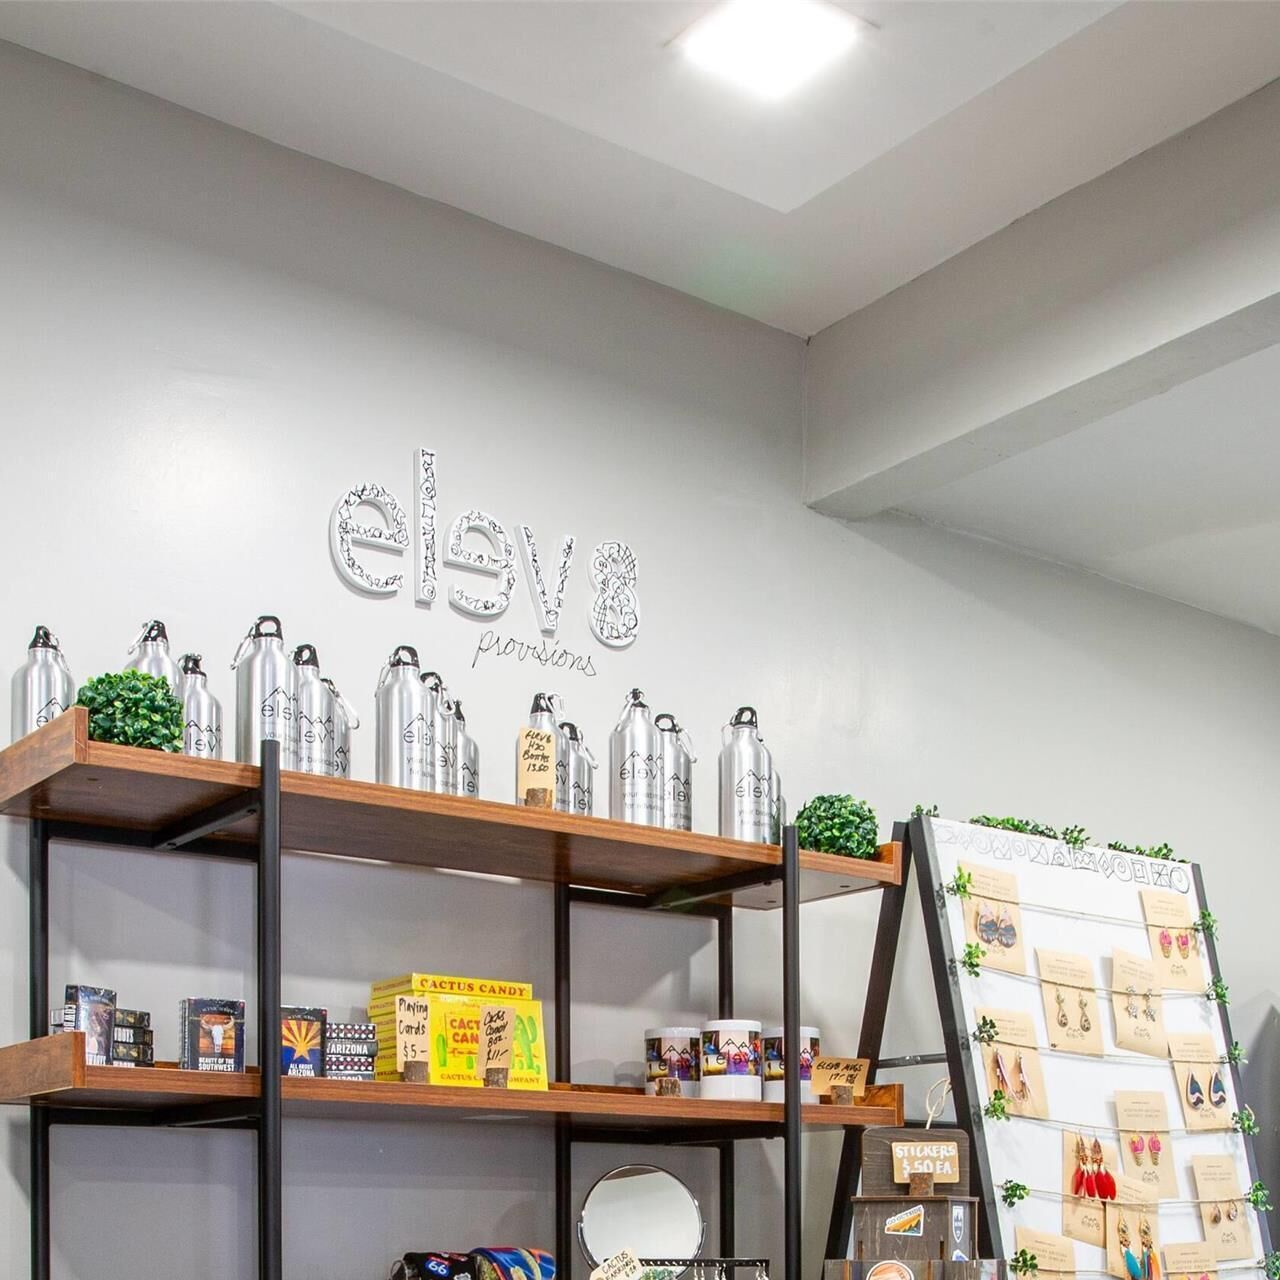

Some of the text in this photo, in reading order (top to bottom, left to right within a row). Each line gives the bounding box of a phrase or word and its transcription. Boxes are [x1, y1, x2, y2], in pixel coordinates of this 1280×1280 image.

[472, 630, 597, 676] provisions
[420, 978, 474, 994] CACTUS
[480, 983, 527, 997] CANDY
[398, 997, 429, 1020] Playing
[399, 1020, 426, 1035] Cards
[450, 1018, 480, 1031] CACT
[452, 1032, 480, 1044] CAN
[330, 1042, 369, 1056] ARIZONA
[198, 1064, 235, 1072] SOUTHWEST
[287, 1068, 315, 1078] ARIZONA
[508, 1077, 540, 1085] OMPANY
[895, 1144, 956, 1159] STICKERS
[428, 1260, 448, 1275] 66
[602, 1250, 629, 1274] CACTUS
